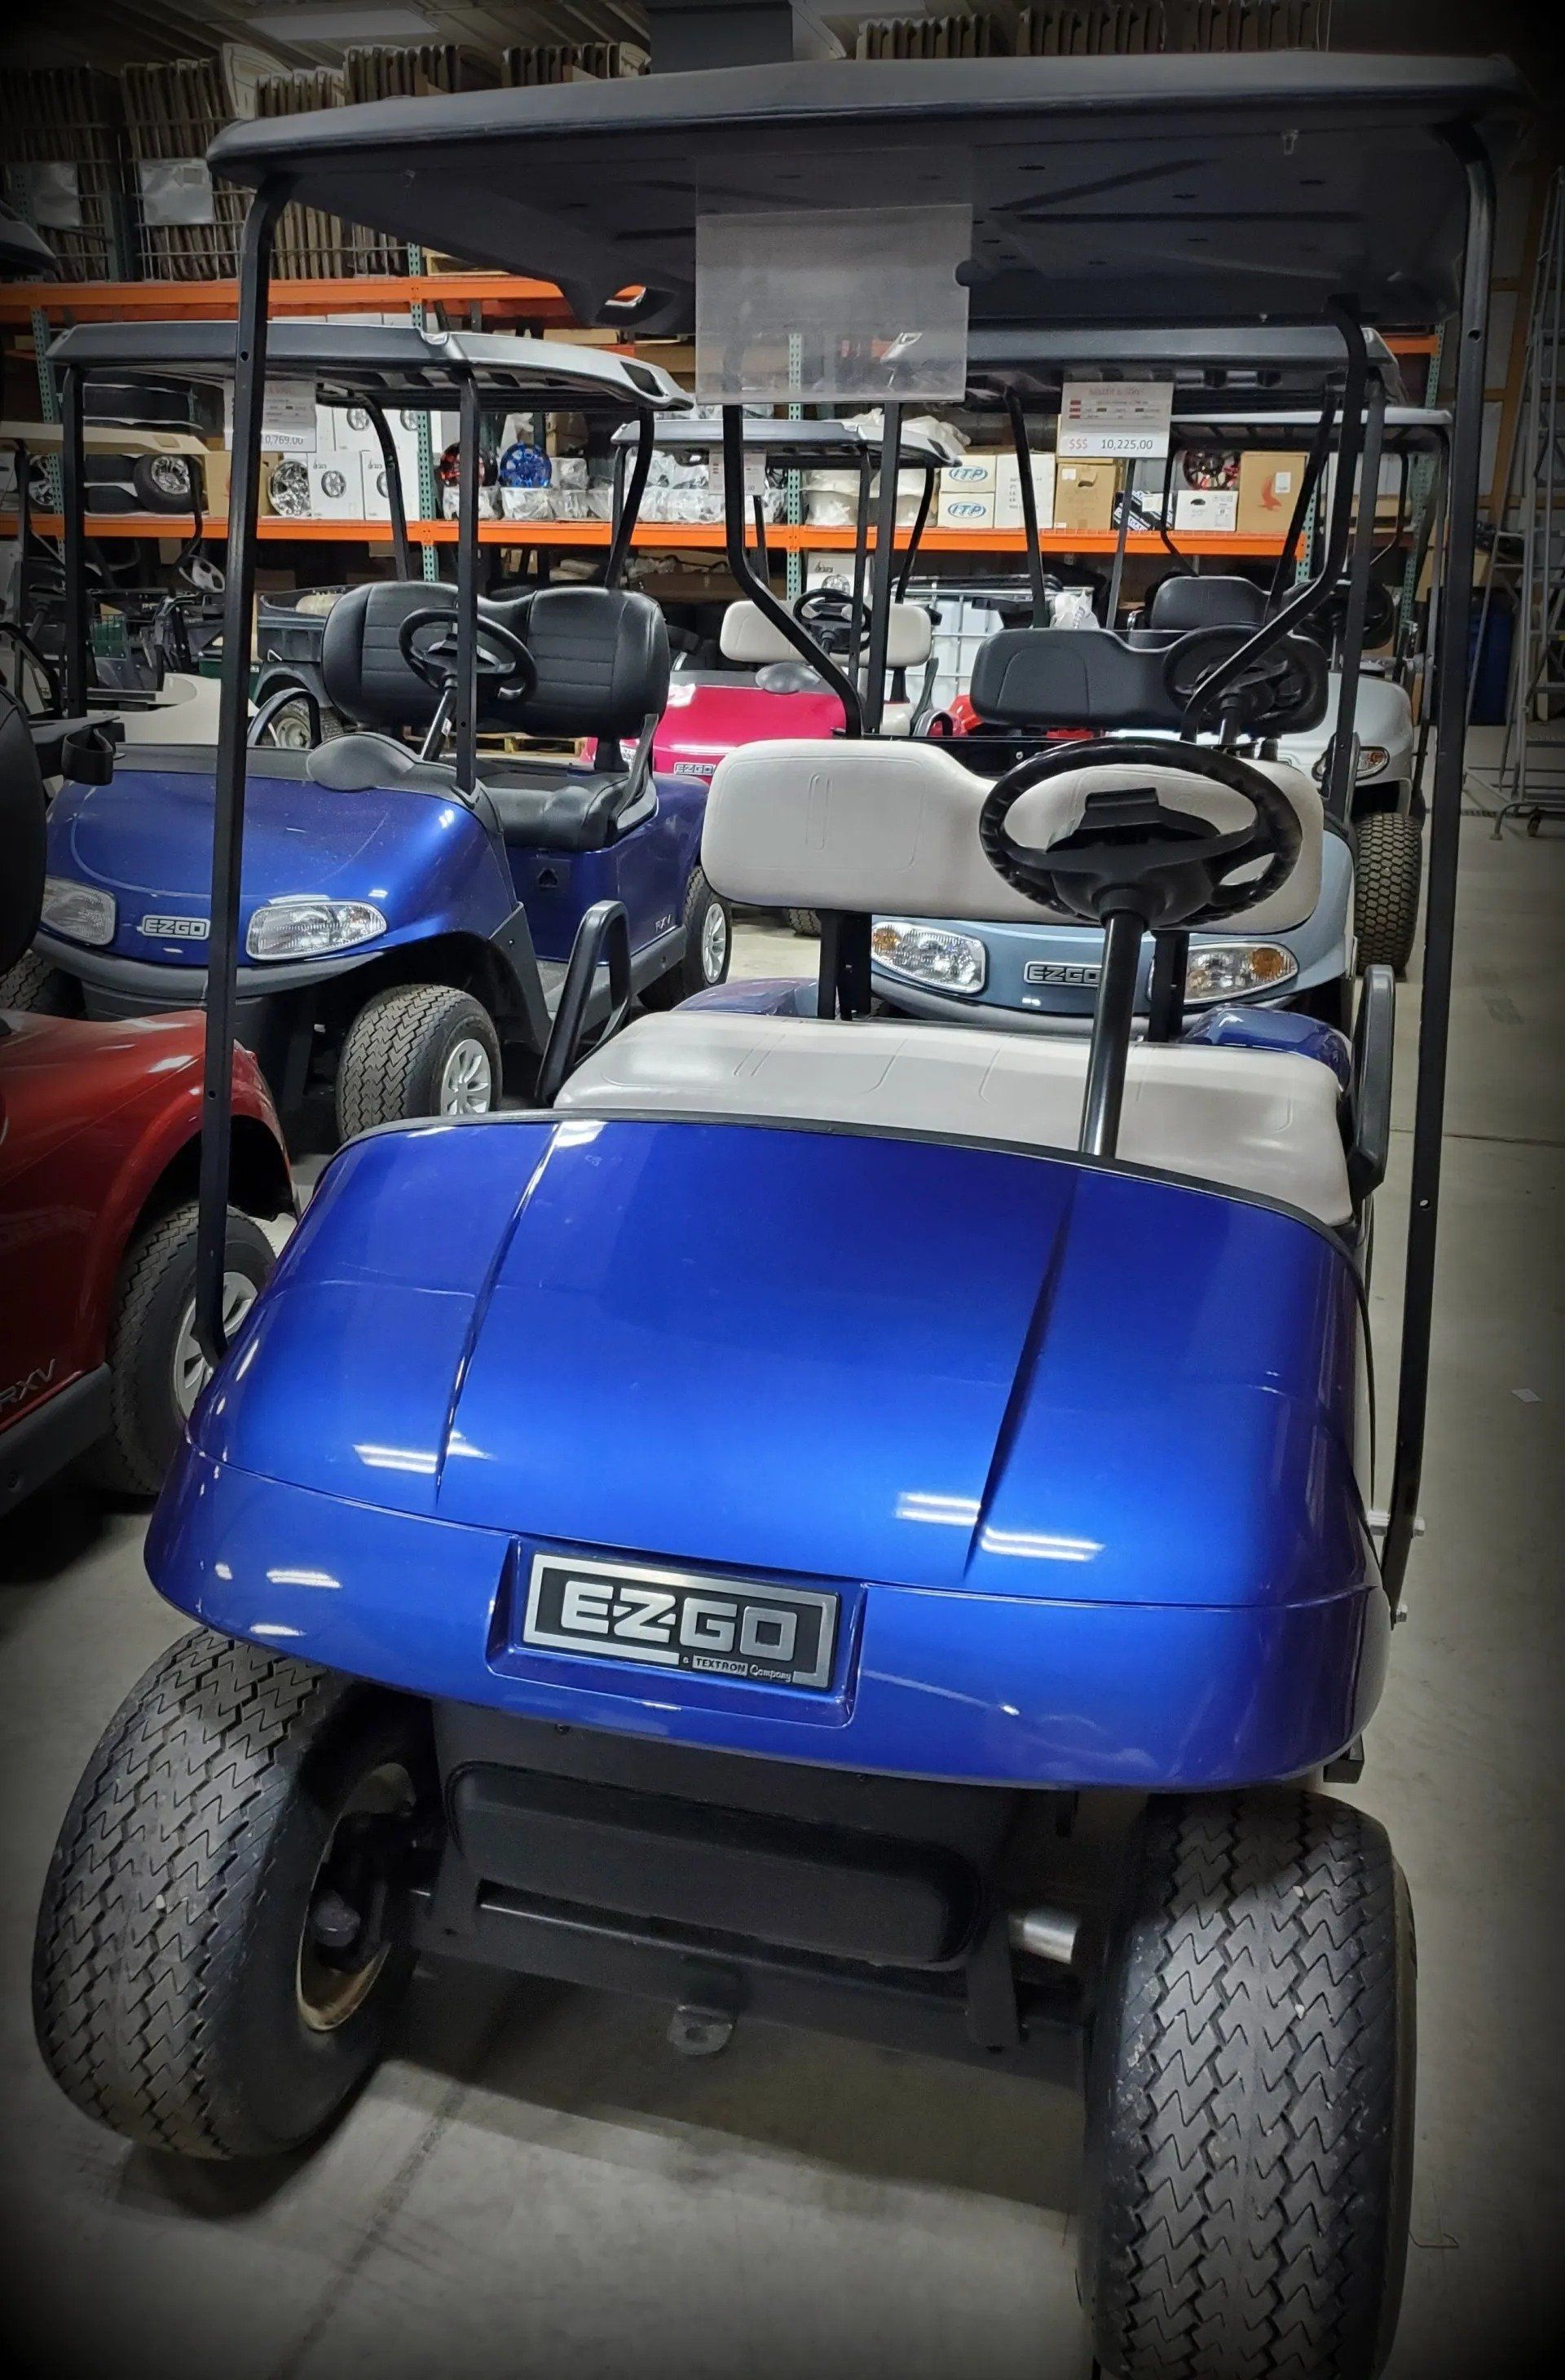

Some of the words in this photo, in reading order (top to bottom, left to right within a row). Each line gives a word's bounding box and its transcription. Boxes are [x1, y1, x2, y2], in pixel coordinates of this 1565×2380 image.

[145, 919, 206, 937] EZGO
[1029, 966, 1100, 984] EZGO
[561, 1580, 797, 1661] EZGO
[696, 1658, 746, 1673] TEXTRON
[749, 1664, 791, 1682] Company
